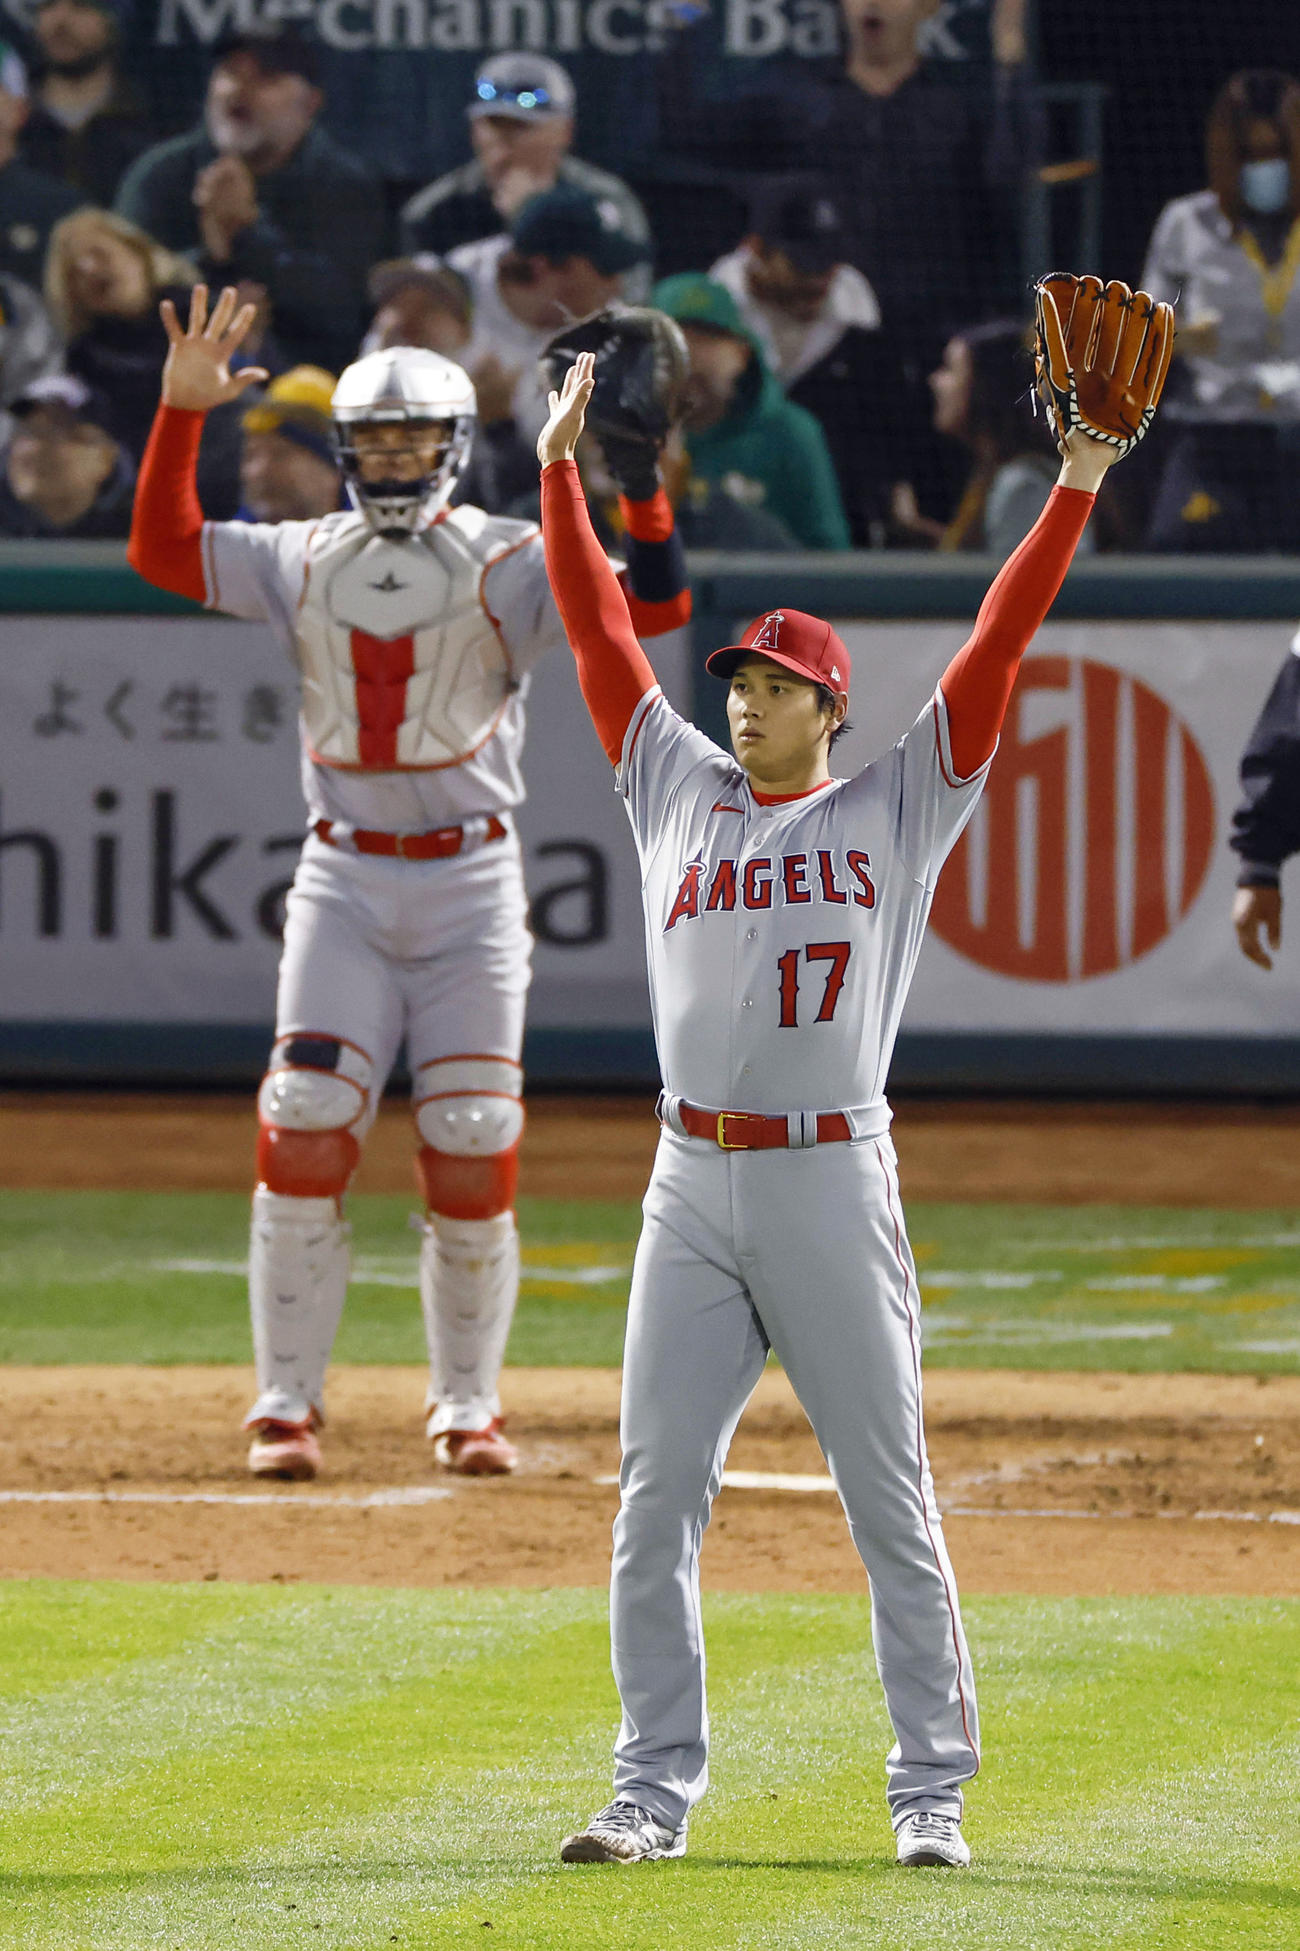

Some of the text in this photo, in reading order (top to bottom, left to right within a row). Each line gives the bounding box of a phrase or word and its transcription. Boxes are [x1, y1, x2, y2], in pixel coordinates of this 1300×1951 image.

[727, 0, 982, 58] Bak
[751, 610, 785, 649] A
[662, 847, 876, 935] ANGELS
[778, 941, 851, 1028] 17
